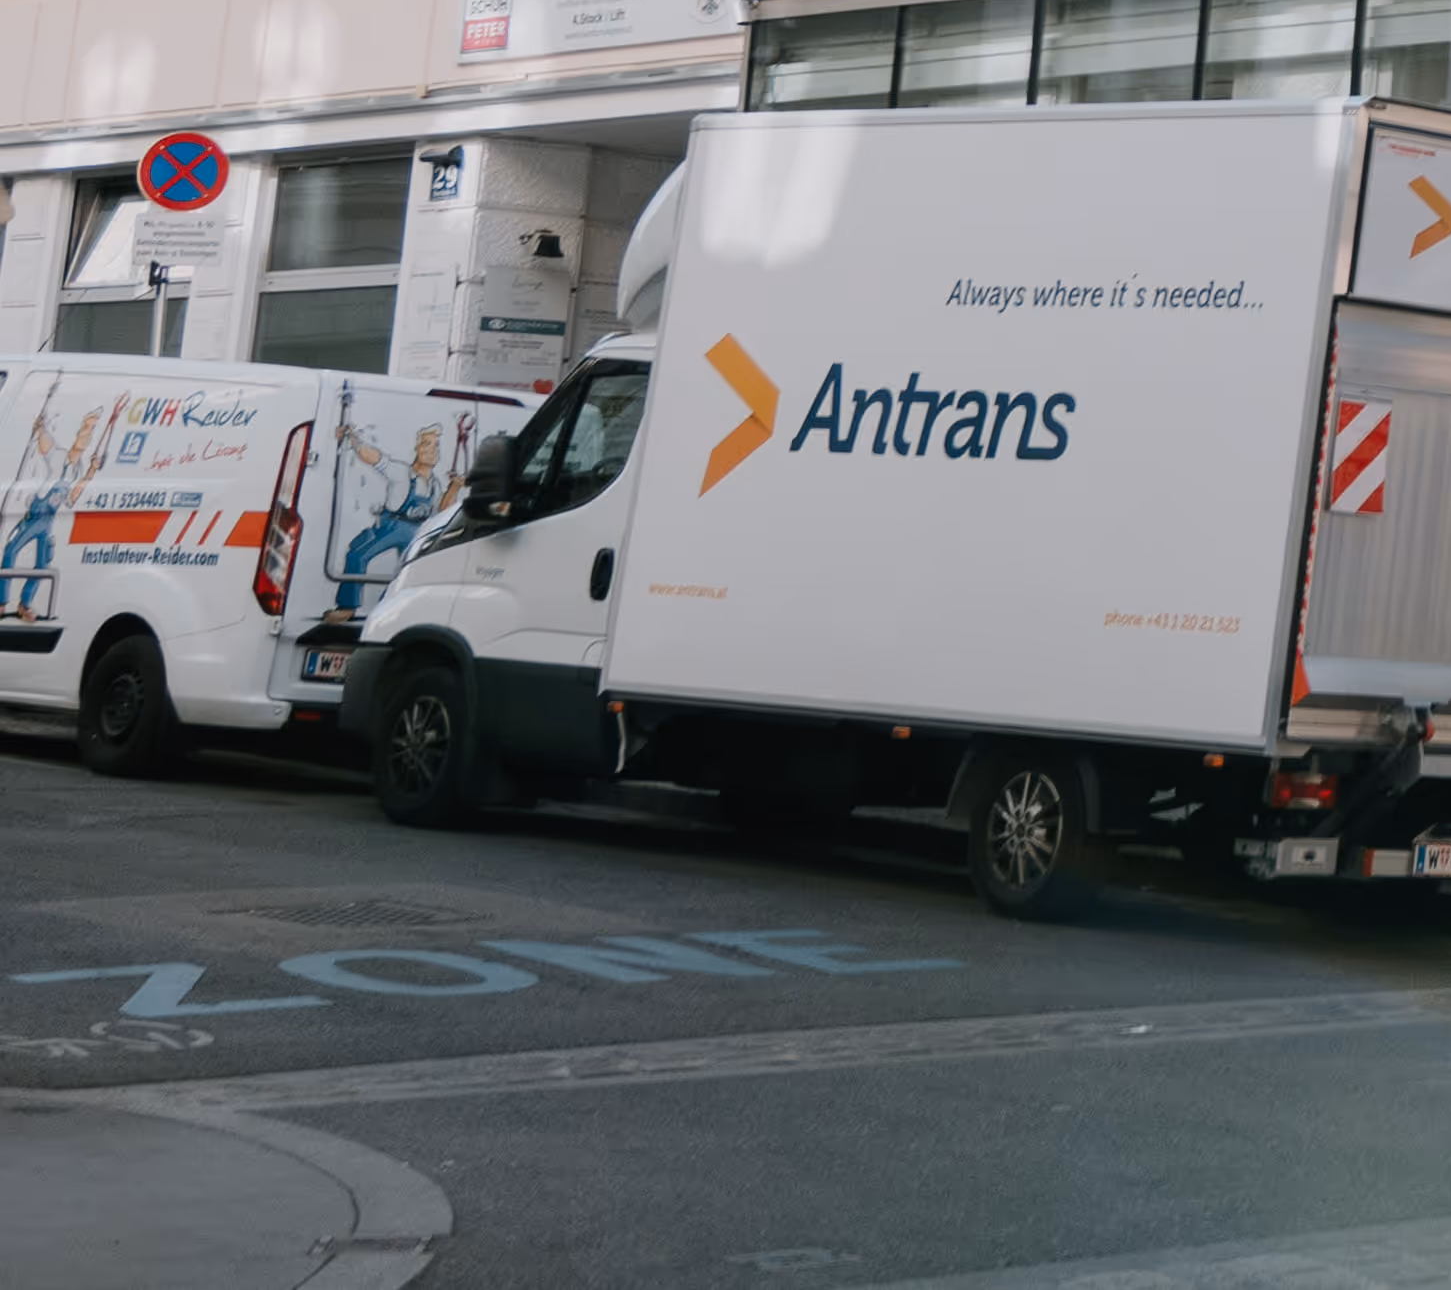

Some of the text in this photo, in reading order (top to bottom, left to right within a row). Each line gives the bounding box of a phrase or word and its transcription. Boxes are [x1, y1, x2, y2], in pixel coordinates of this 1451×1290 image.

[466, 20, 505, 40] PETER
[433, 165, 457, 190] 29
[945, 278, 1026, 313] Always
[1032, 279, 1104, 308] where
[1151, 279, 1265, 309] needed...
[127, 390, 258, 428] GWH Reider
[789, 363, 1076, 461] Antrans
[81, 544, 220, 567] Installateur-Reider.com
[1428, 848, 1441, 867] W
[11, 928, 966, 1019] ZONE
